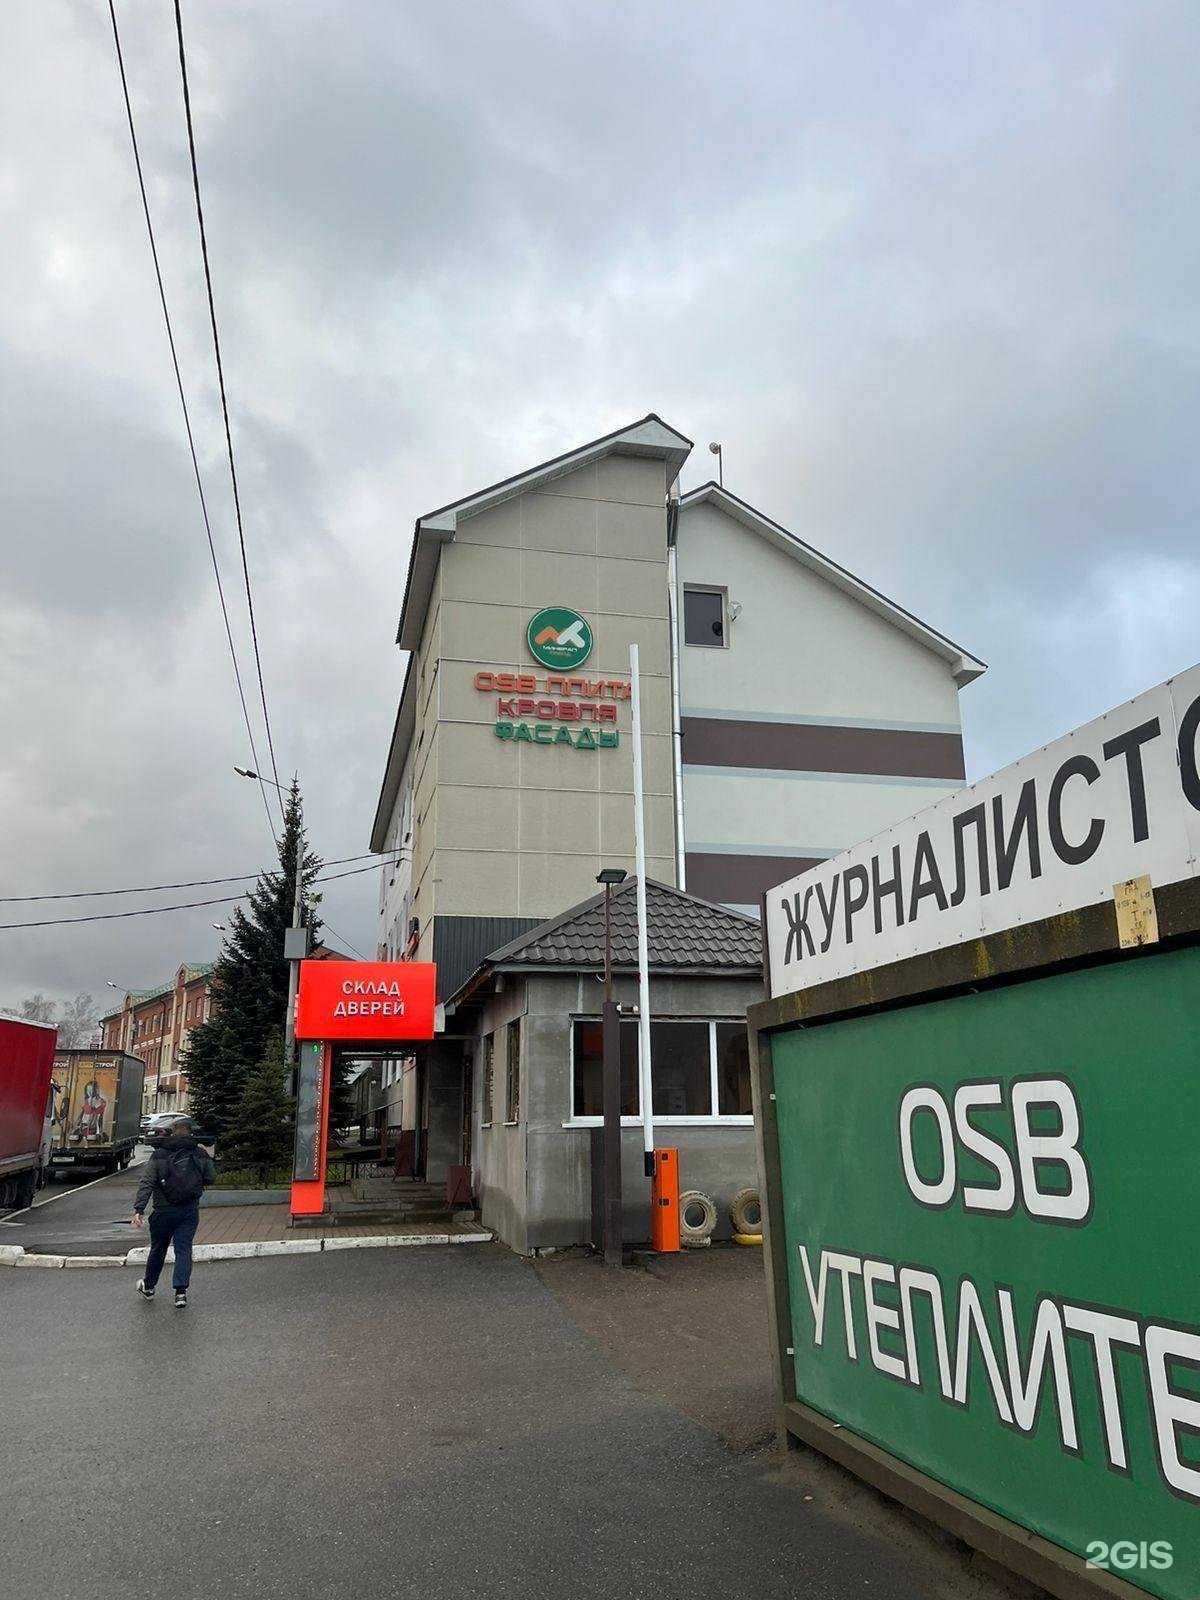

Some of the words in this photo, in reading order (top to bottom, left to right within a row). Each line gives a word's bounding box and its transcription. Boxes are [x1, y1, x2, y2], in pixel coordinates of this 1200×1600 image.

[475, 672, 536, 695] OSB
[497, 699, 617, 723] КРОВЛЯ
[494, 722, 619, 750] ФАСАДЫ
[342, 980, 401, 997] СКЛАД
[333, 998, 405, 1017] ДВЕРЕЙ
[898, 1077, 1092, 1222] OSB
[797, 1245, 1200, 1499] УТЕПЛИТЕ
